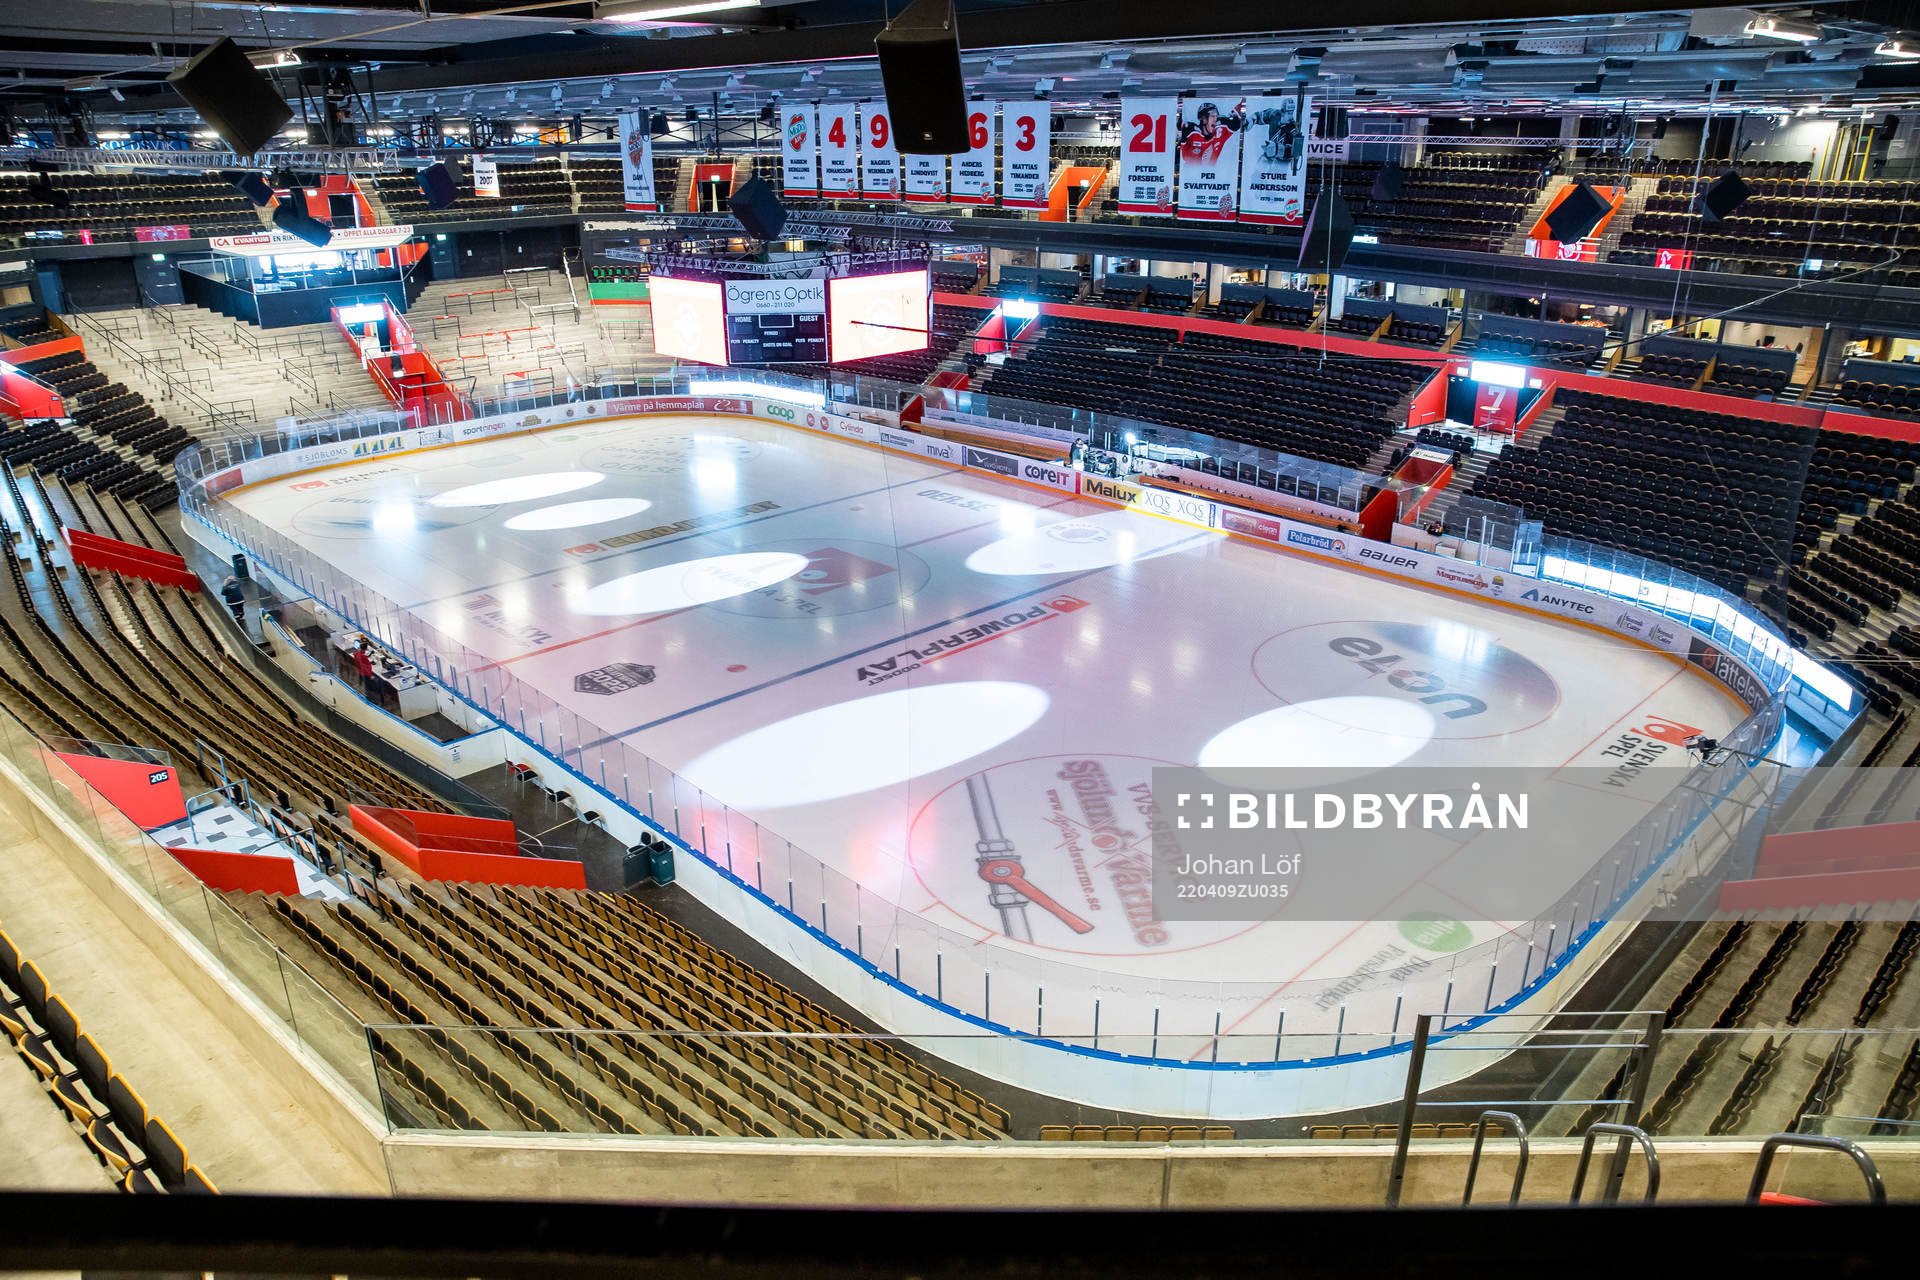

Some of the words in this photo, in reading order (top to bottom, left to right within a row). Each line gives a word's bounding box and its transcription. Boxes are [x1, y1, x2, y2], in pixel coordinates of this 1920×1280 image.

[829, 117, 846, 148] 4
[870, 114, 889, 149] 9
[1015, 116, 1036, 151] 3
[1129, 114, 1167, 152] 21
[1128, 174, 1164, 182] FORSBERG
[1184, 182, 1230, 190] SVARTVADET
[1260, 172, 1288, 180] STURE
[1250, 184, 1298, 192] ANDERSSON
[213, 238, 229, 247] ICA
[234, 236, 270, 244] KVANTUM
[363, 228, 376, 236] ALLA
[728, 285, 780, 304] Ögrens
[784, 286, 824, 303] Optik
[612, 402, 642, 412] Värme
[644, 402, 654, 412] på
[656, 401, 704, 412] hemmaplan
[1488, 386, 1506, 412] 7
[767, 404, 795, 420] coop
[463, 422, 506, 435] sportringen
[840, 421, 864, 434] Cylinda
[927, 444, 950, 458] miva
[1024, 464, 1070, 486] coreIT
[1086, 480, 1137, 504] Malux
[1145, 490, 1172, 510] XQS
[1177, 498, 1205, 519] XQS
[1289, 530, 1330, 550] Polarbröd
[1359, 548, 1418, 570] BAUER
[1541, 594, 1595, 614] ANYTEC
[856, 604, 1052, 682] POWERPLAY
[868, 662, 921, 686] ODDSET
[1329, 636, 1488, 720] elon
[1601, 734, 1642, 758] SPEL
[1602, 742, 1668, 788] SVENSKA
[150, 771, 168, 782] 205
